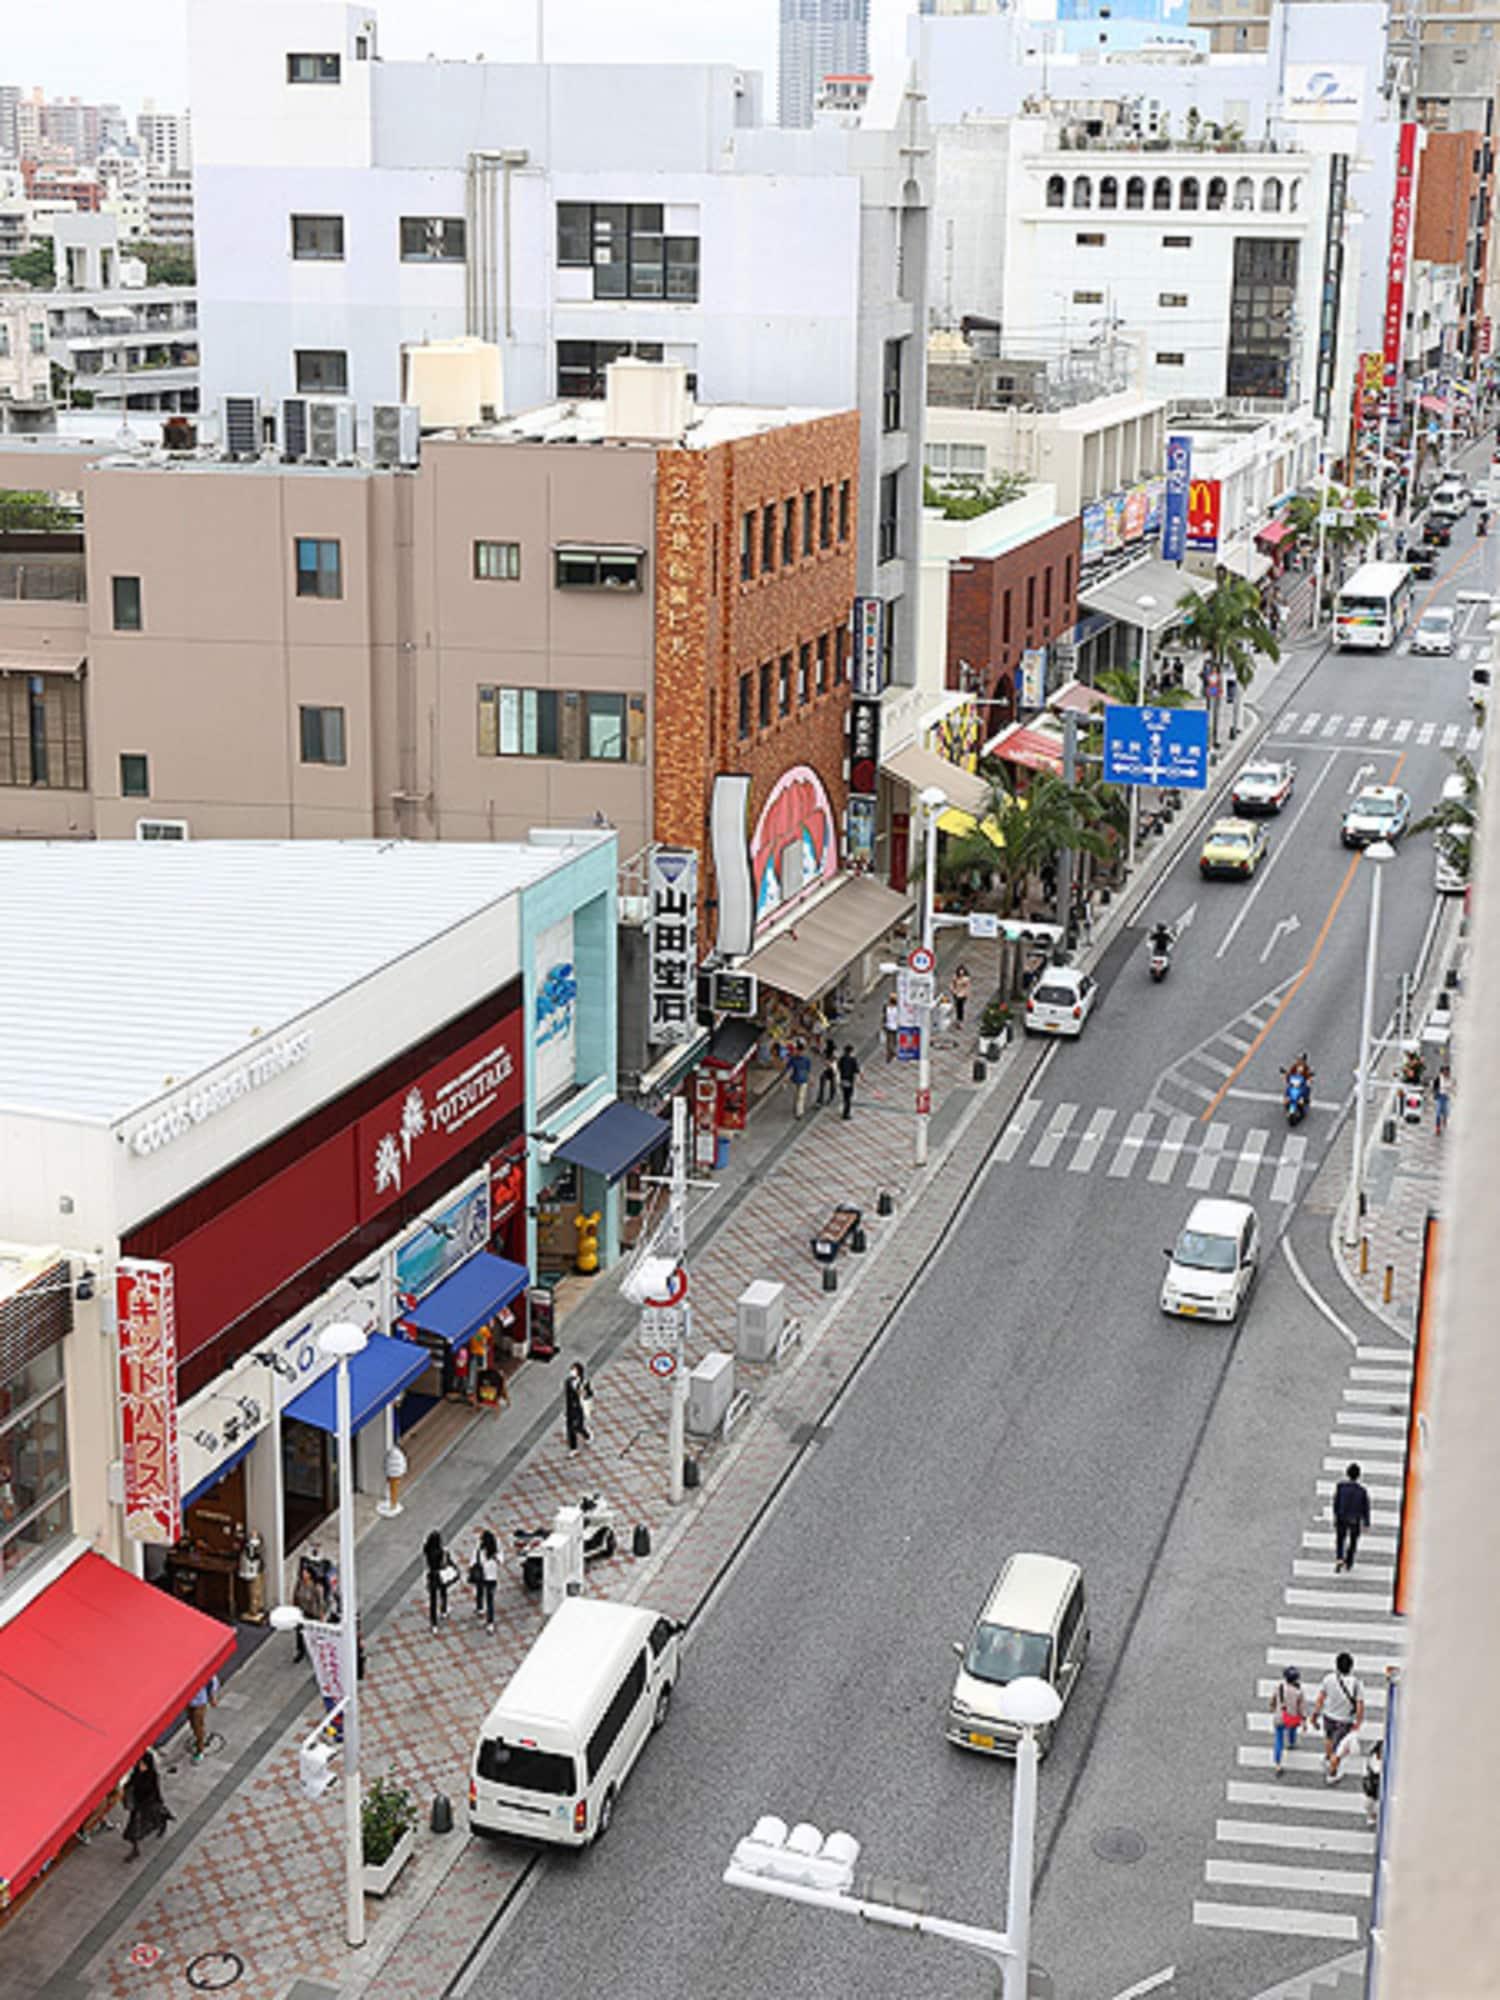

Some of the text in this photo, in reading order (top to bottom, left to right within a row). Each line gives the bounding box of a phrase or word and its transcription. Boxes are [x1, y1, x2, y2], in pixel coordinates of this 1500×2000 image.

[653, 887, 688, 1023] 山田宝石
[429, 1053, 514, 1131] YOTSUTAKE
[131, 1295, 165, 1493] キッドハウス
